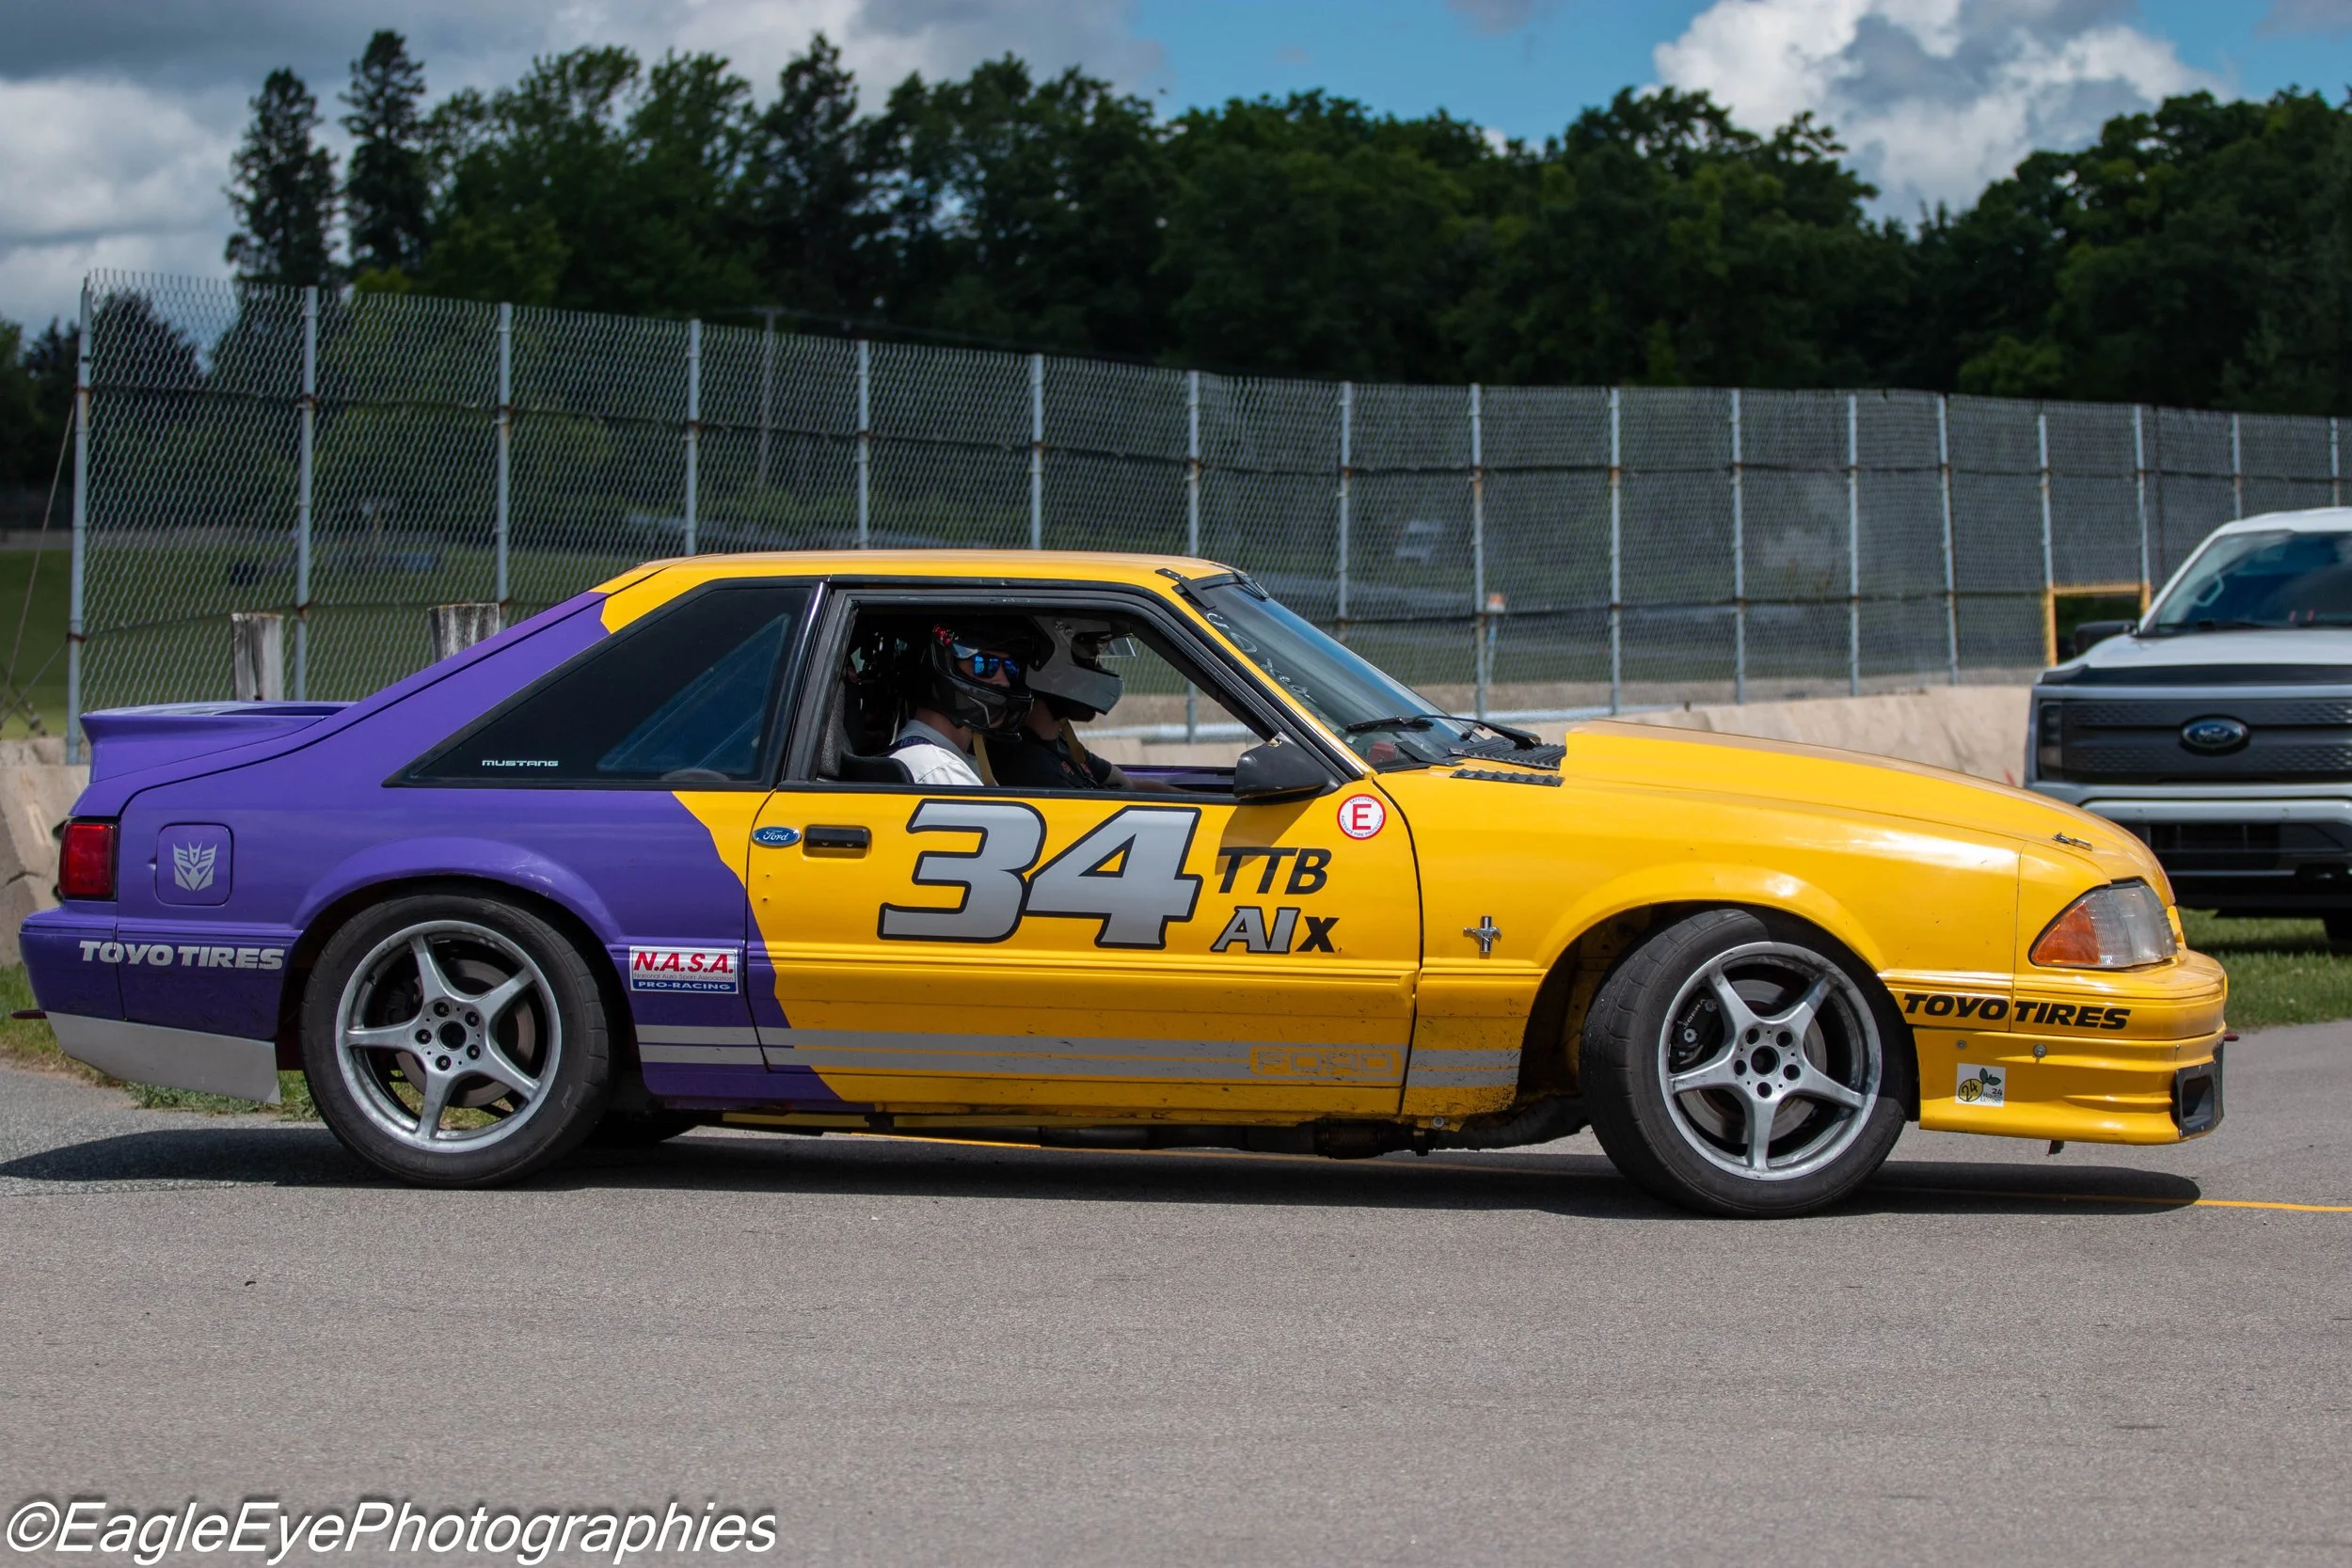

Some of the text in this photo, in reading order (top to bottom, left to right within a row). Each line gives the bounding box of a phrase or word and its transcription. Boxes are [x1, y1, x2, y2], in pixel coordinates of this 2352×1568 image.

[1352, 804, 1372, 830] E
[877, 799, 1203, 950] 34
[1217, 847, 1332, 895] TTB
[79, 941, 285, 970] TOYO TIRES
[633, 951, 734, 974] N.A.S.A.
[638, 981, 730, 990] PRO-RACING
[1903, 993, 2131, 1030] TOYO TIRES
